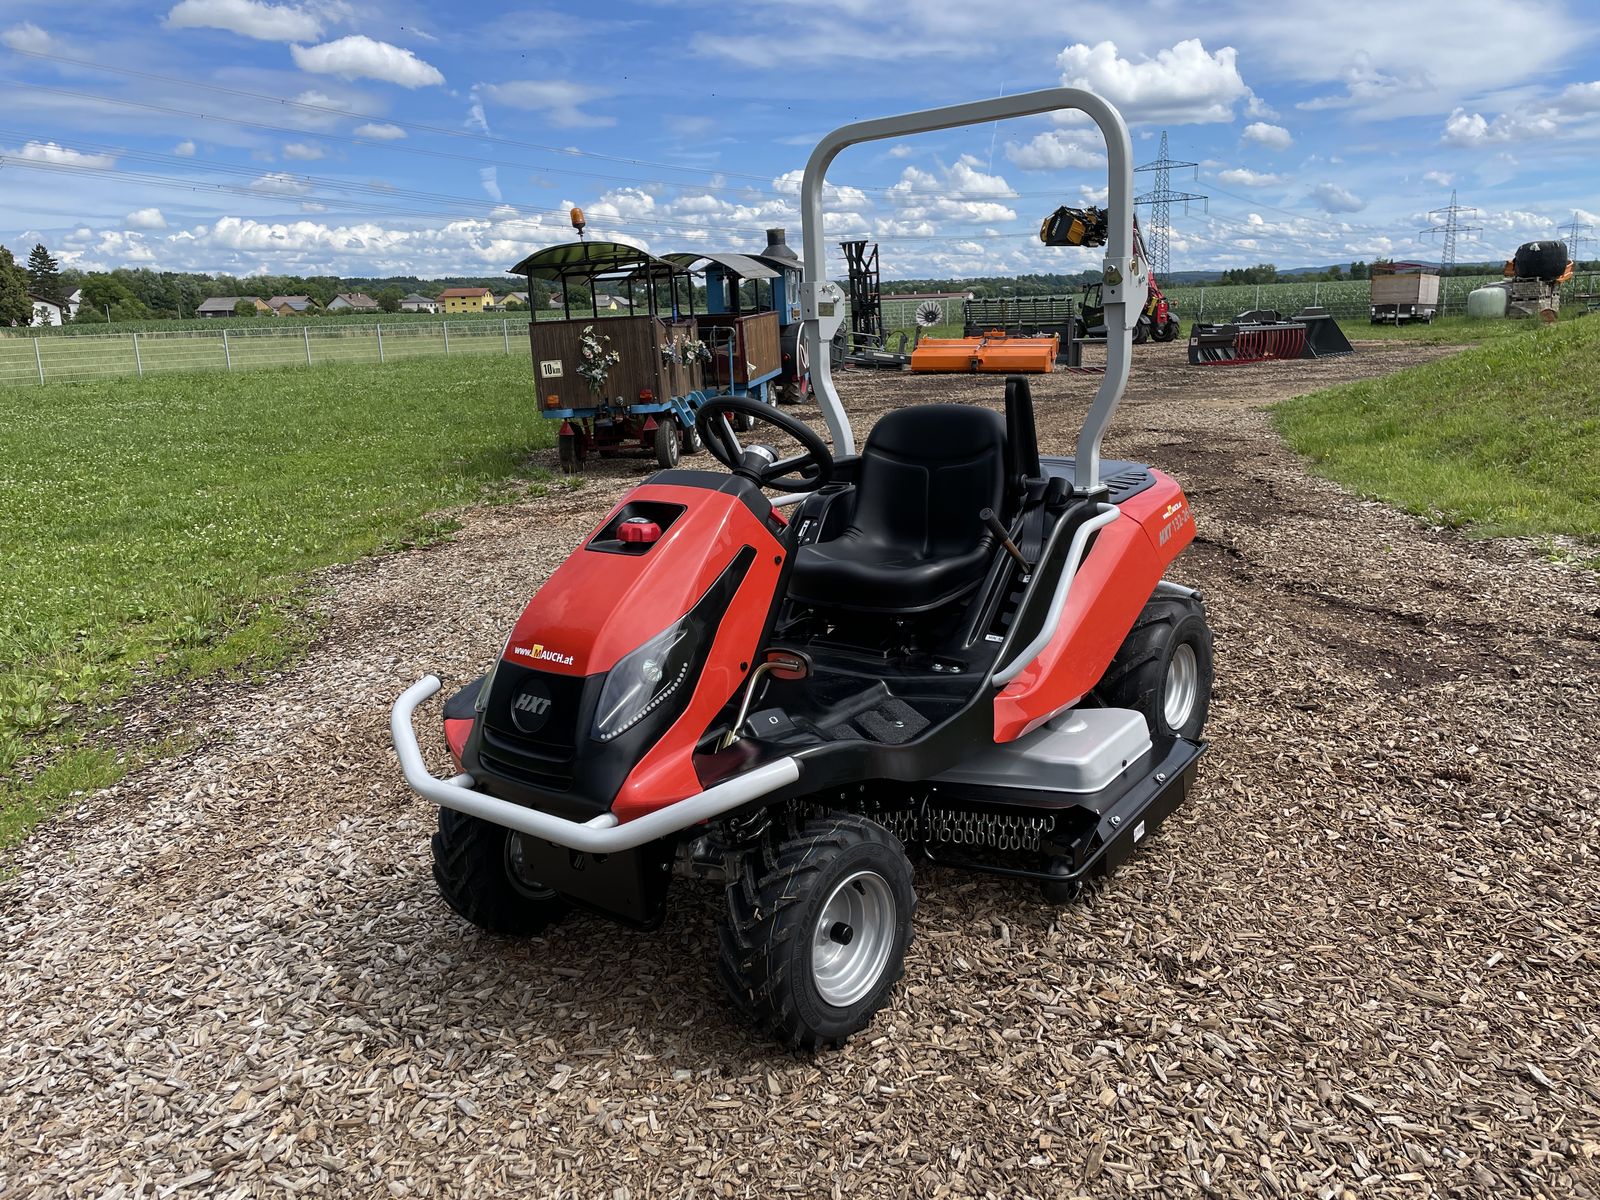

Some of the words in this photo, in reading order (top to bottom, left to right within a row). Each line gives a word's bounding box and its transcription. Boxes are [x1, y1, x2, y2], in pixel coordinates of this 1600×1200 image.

[543, 363, 552, 375] 10
[552, 366, 561, 374] km
[514, 693, 552, 716] HXT
